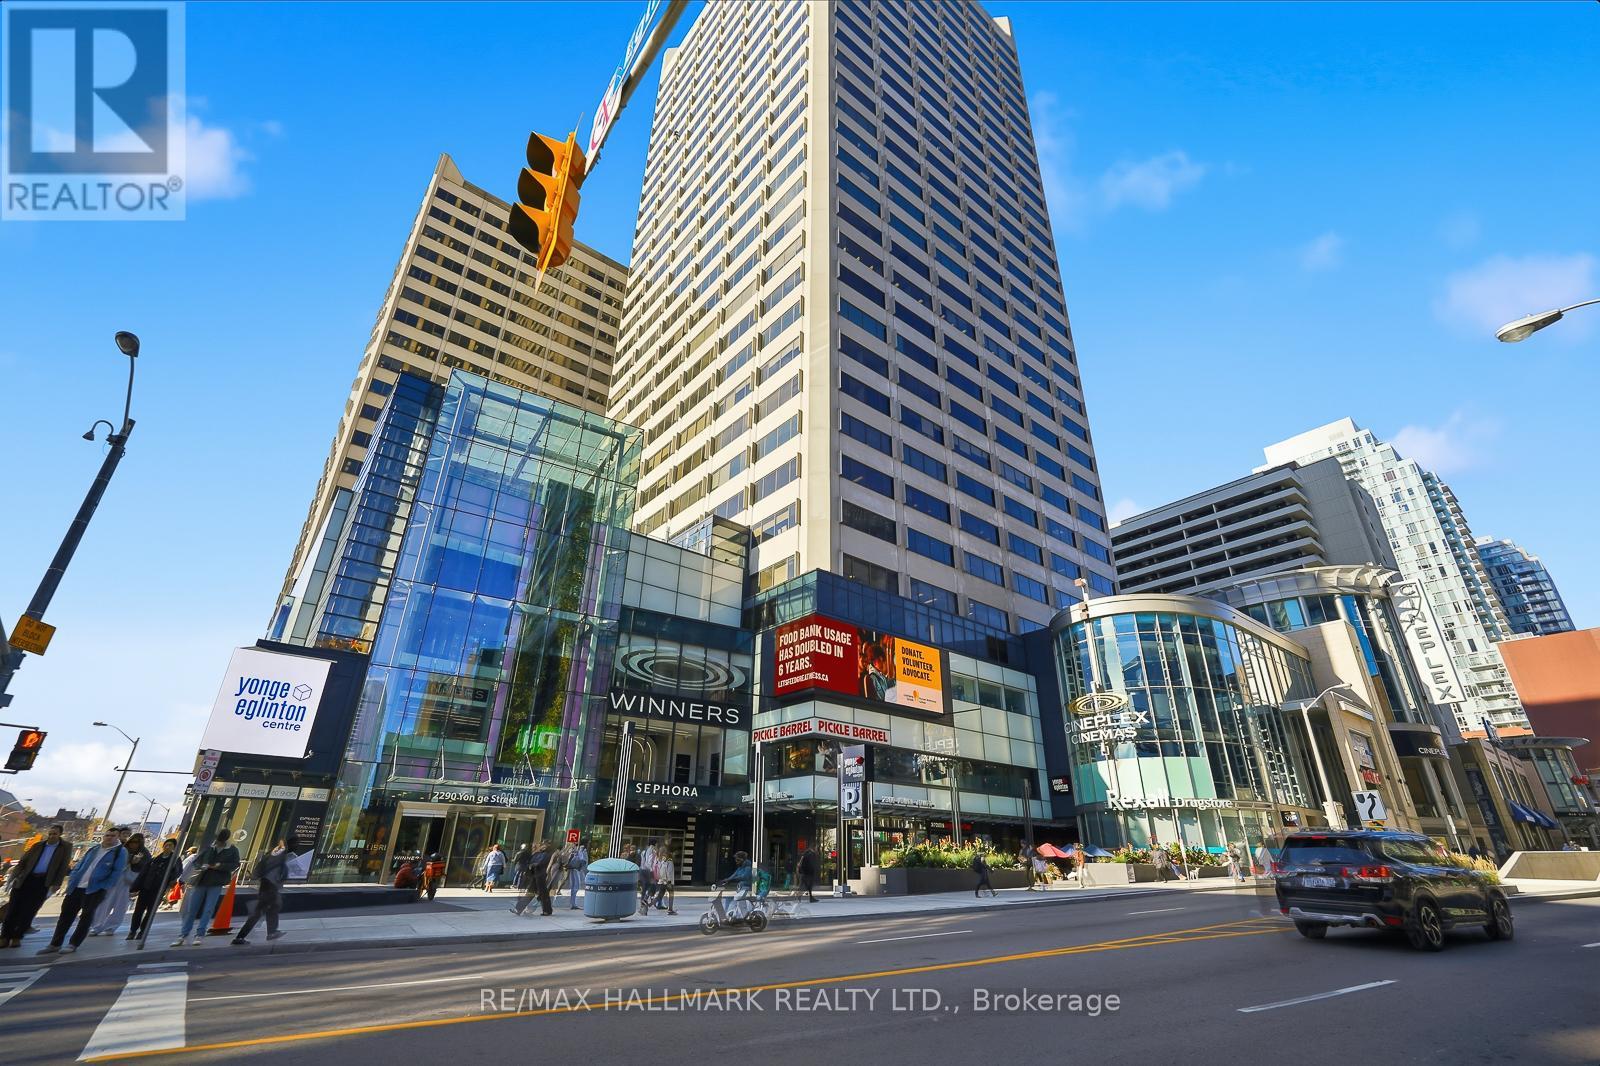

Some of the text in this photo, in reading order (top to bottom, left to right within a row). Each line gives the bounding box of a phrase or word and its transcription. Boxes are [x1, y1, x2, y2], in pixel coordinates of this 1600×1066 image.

[780, 624, 852, 647] FOOD BANK USAGE
[1399, 584, 1457, 701] CINEPLEX
[779, 640, 843, 661] HAS DOUBLED IN
[901, 647, 925, 660] DONATE.
[778, 656, 812, 676] 6 YEARS.
[902, 657, 935, 673] VOLUNTEER.
[903, 667, 933, 681] ADVOCATE.
[234, 676, 291, 701] yonge
[234, 696, 307, 722] eglinton
[610, 692, 740, 724] WINNERS
[262, 721, 301, 732] centre
[753, 720, 813, 742] PICKLE BARREL
[818, 720, 888, 742] PICKLE BARREL
[1063, 711, 1150, 734] CINEPLEX
[1071, 727, 1138, 745] CINEMAS
[433, 791, 457, 801] 2290
[635, 782, 698, 797] SEPHORA
[1105, 790, 1233, 811] Rexall Drugstore
